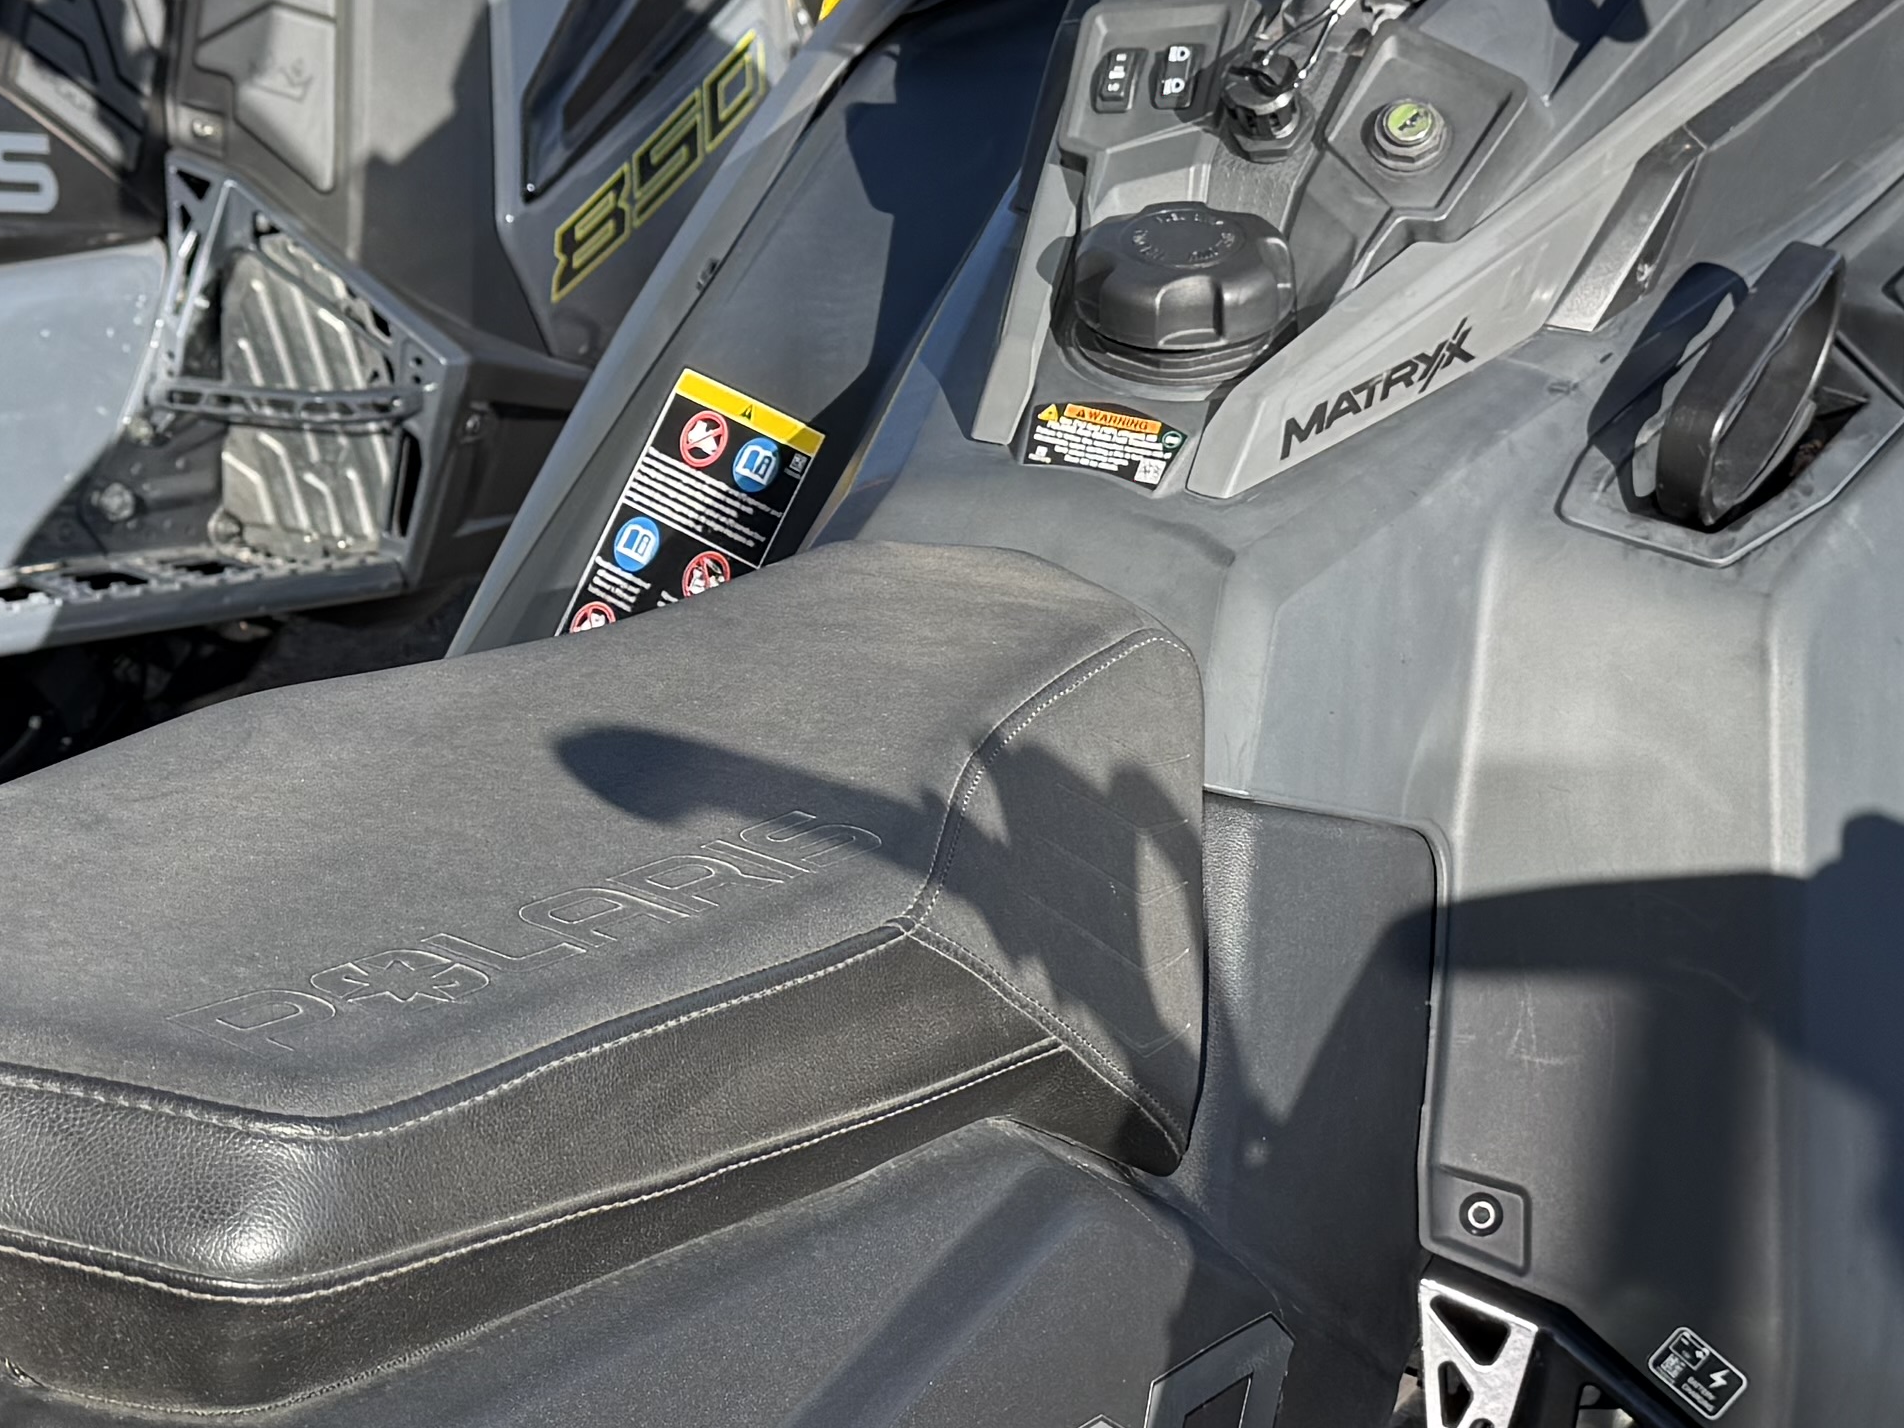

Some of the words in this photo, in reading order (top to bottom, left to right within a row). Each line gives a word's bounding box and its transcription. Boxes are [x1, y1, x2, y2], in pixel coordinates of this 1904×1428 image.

[551, 28, 767, 303] 850
[1088, 411, 1148, 432] WARNING
[1280, 316, 1476, 461] MATRYX
[165, 809, 883, 1061] POLARIS
